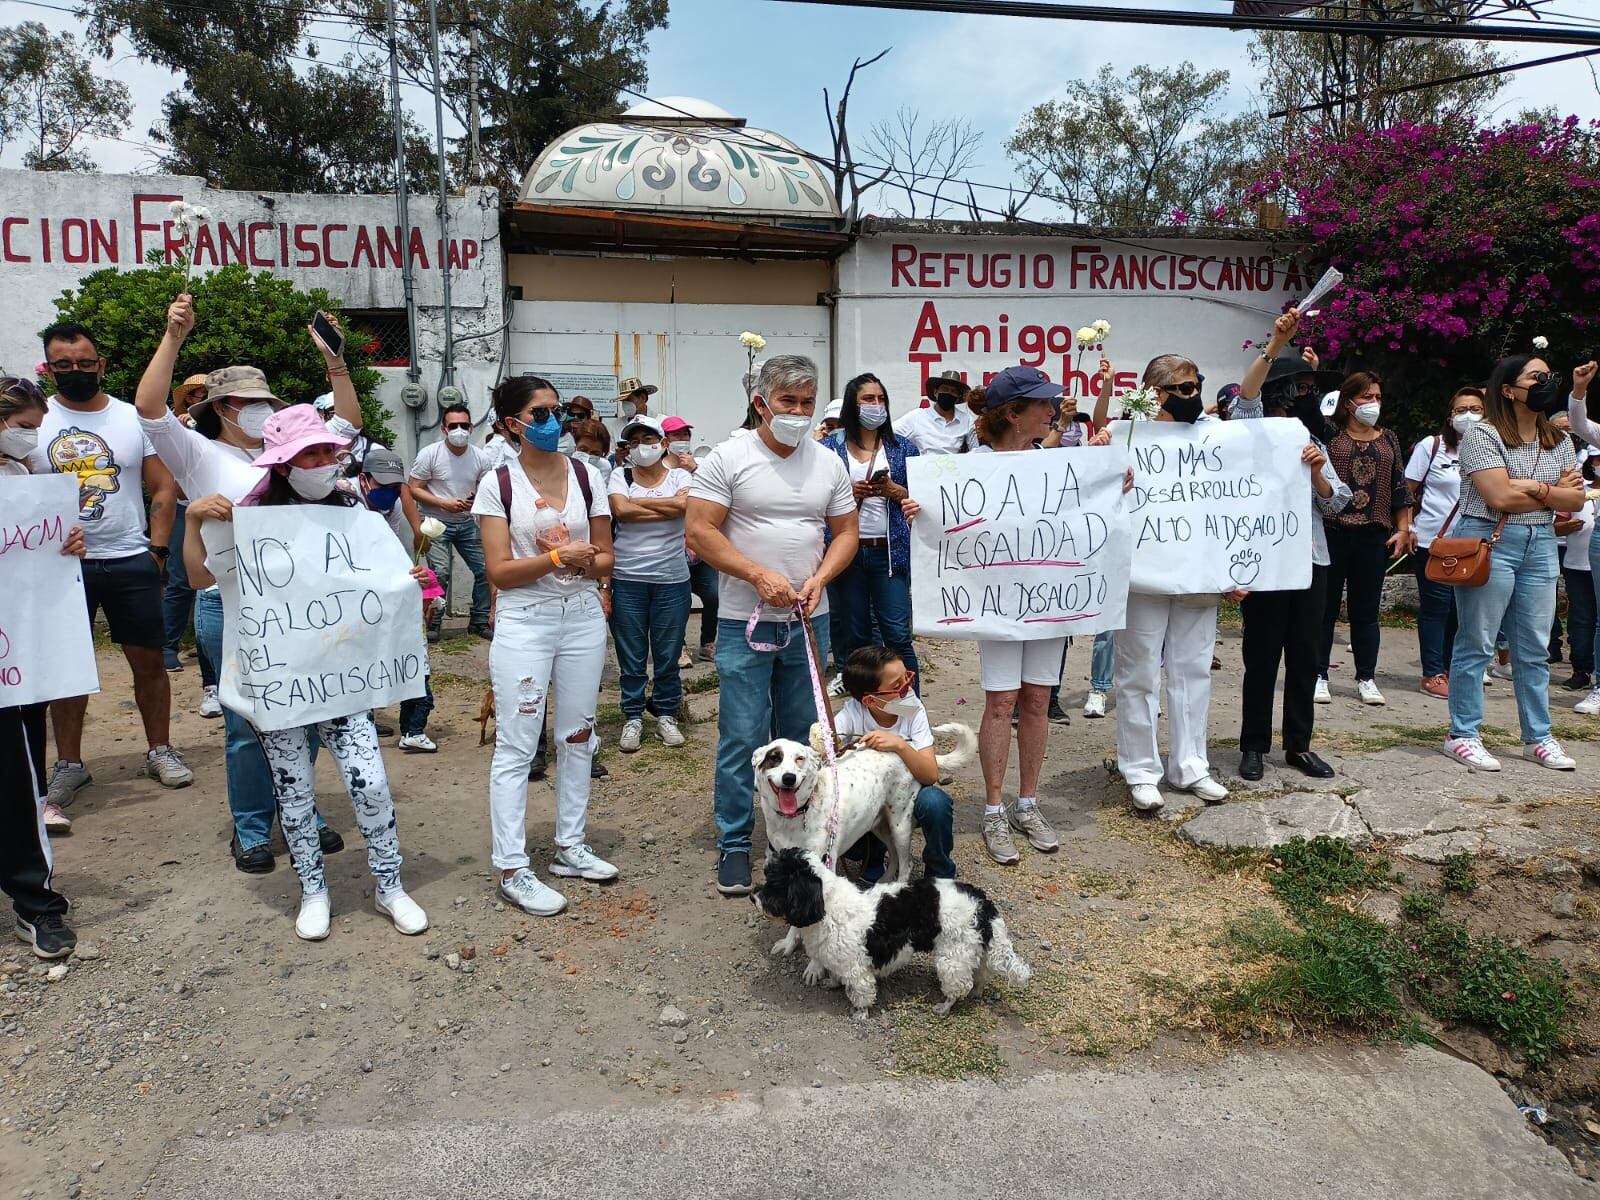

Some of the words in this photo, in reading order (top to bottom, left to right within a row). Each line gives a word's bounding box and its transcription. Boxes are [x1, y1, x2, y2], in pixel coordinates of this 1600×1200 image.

[0, 217, 119, 263] CION
[133, 194, 430, 269] FRANCISCANA
[438, 239, 478, 270] IAP
[892, 244, 1054, 289] REFUGIO
[1070, 246, 1274, 291] FRANCISCANO
[1135, 444, 1165, 475] NO
[1178, 435, 1223, 478] MÁS
[940, 478, 986, 525] NO
[995, 474, 1024, 520] A
[1042, 462, 1080, 516] LA
[1129, 474, 1263, 513] DESARROLLOS
[937, 513, 1108, 578] ILEGALIDAD
[1137, 515, 1192, 549] ALTO
[235, 538, 295, 597] NO
[325, 532, 372, 573] AL
[941, 585, 971, 617] NO
[982, 585, 1008, 617] AL
[1014, 572, 1108, 621] DESALOJO
[239, 645, 287, 675] DEL
[241, 653, 419, 713] FRANCISCANO
